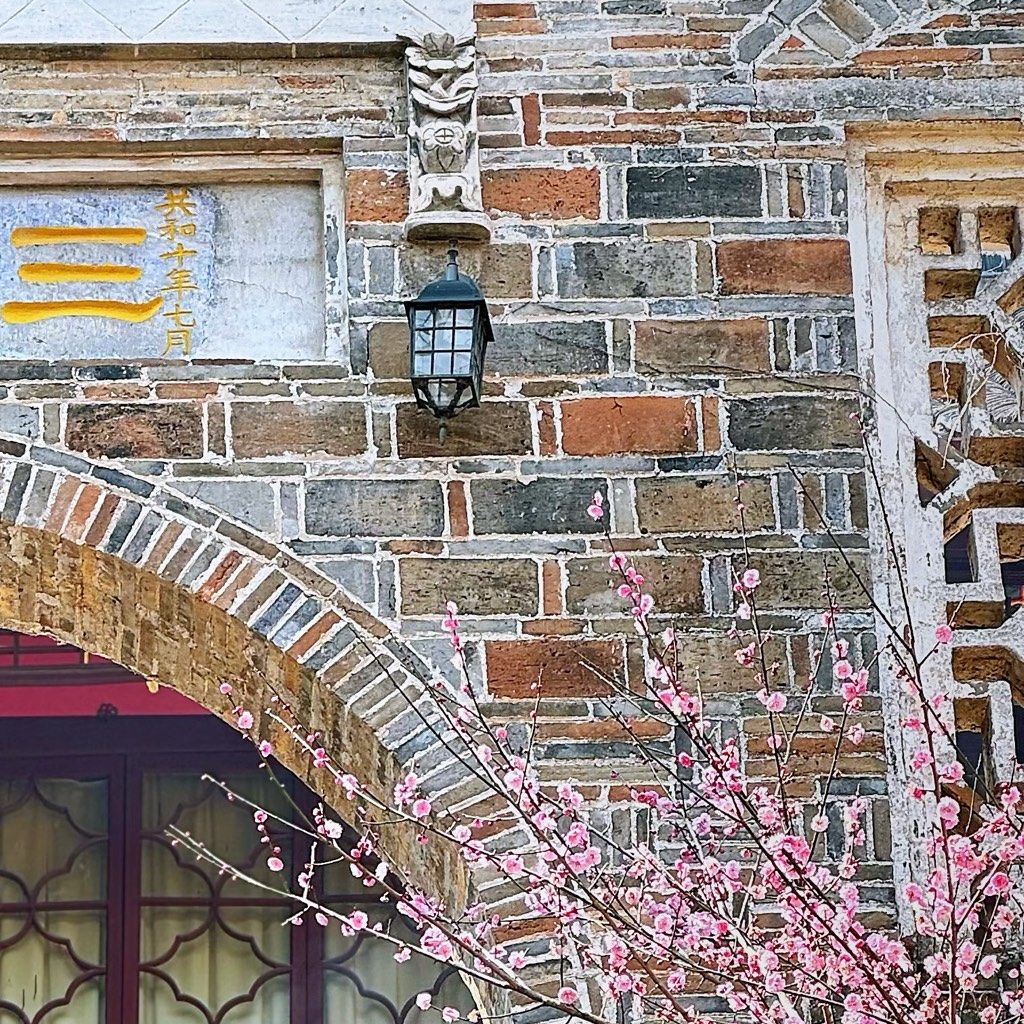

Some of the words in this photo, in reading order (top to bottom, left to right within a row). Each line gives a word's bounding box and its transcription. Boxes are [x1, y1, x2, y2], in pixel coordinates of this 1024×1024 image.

[154, 187, 198, 357] 共和十年七月
